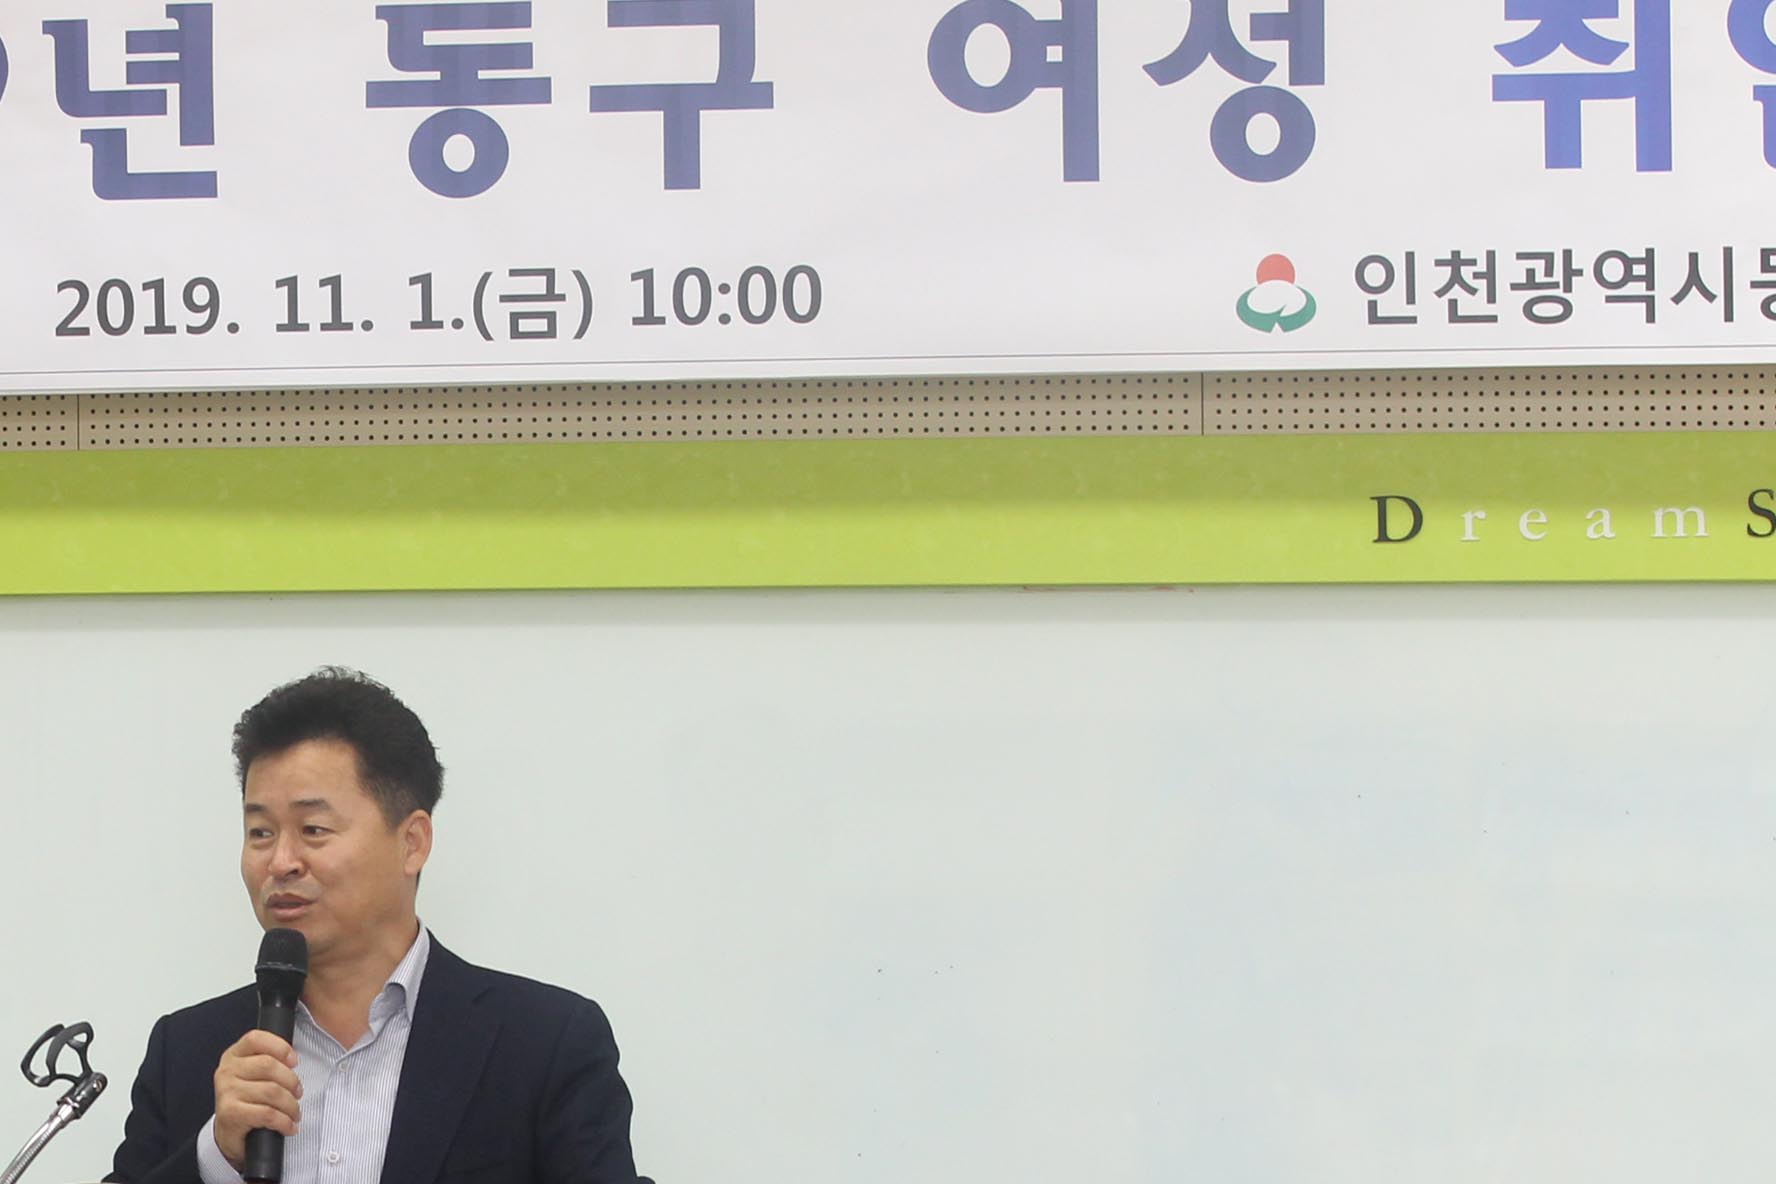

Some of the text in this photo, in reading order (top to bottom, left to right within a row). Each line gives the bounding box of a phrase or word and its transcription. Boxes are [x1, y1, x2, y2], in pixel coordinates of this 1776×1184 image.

[365, 0, 774, 199] 동구
[926, 0, 1326, 183] 여성
[55, 264, 822, 342] 2019. 11. 1.(금) 10:00
